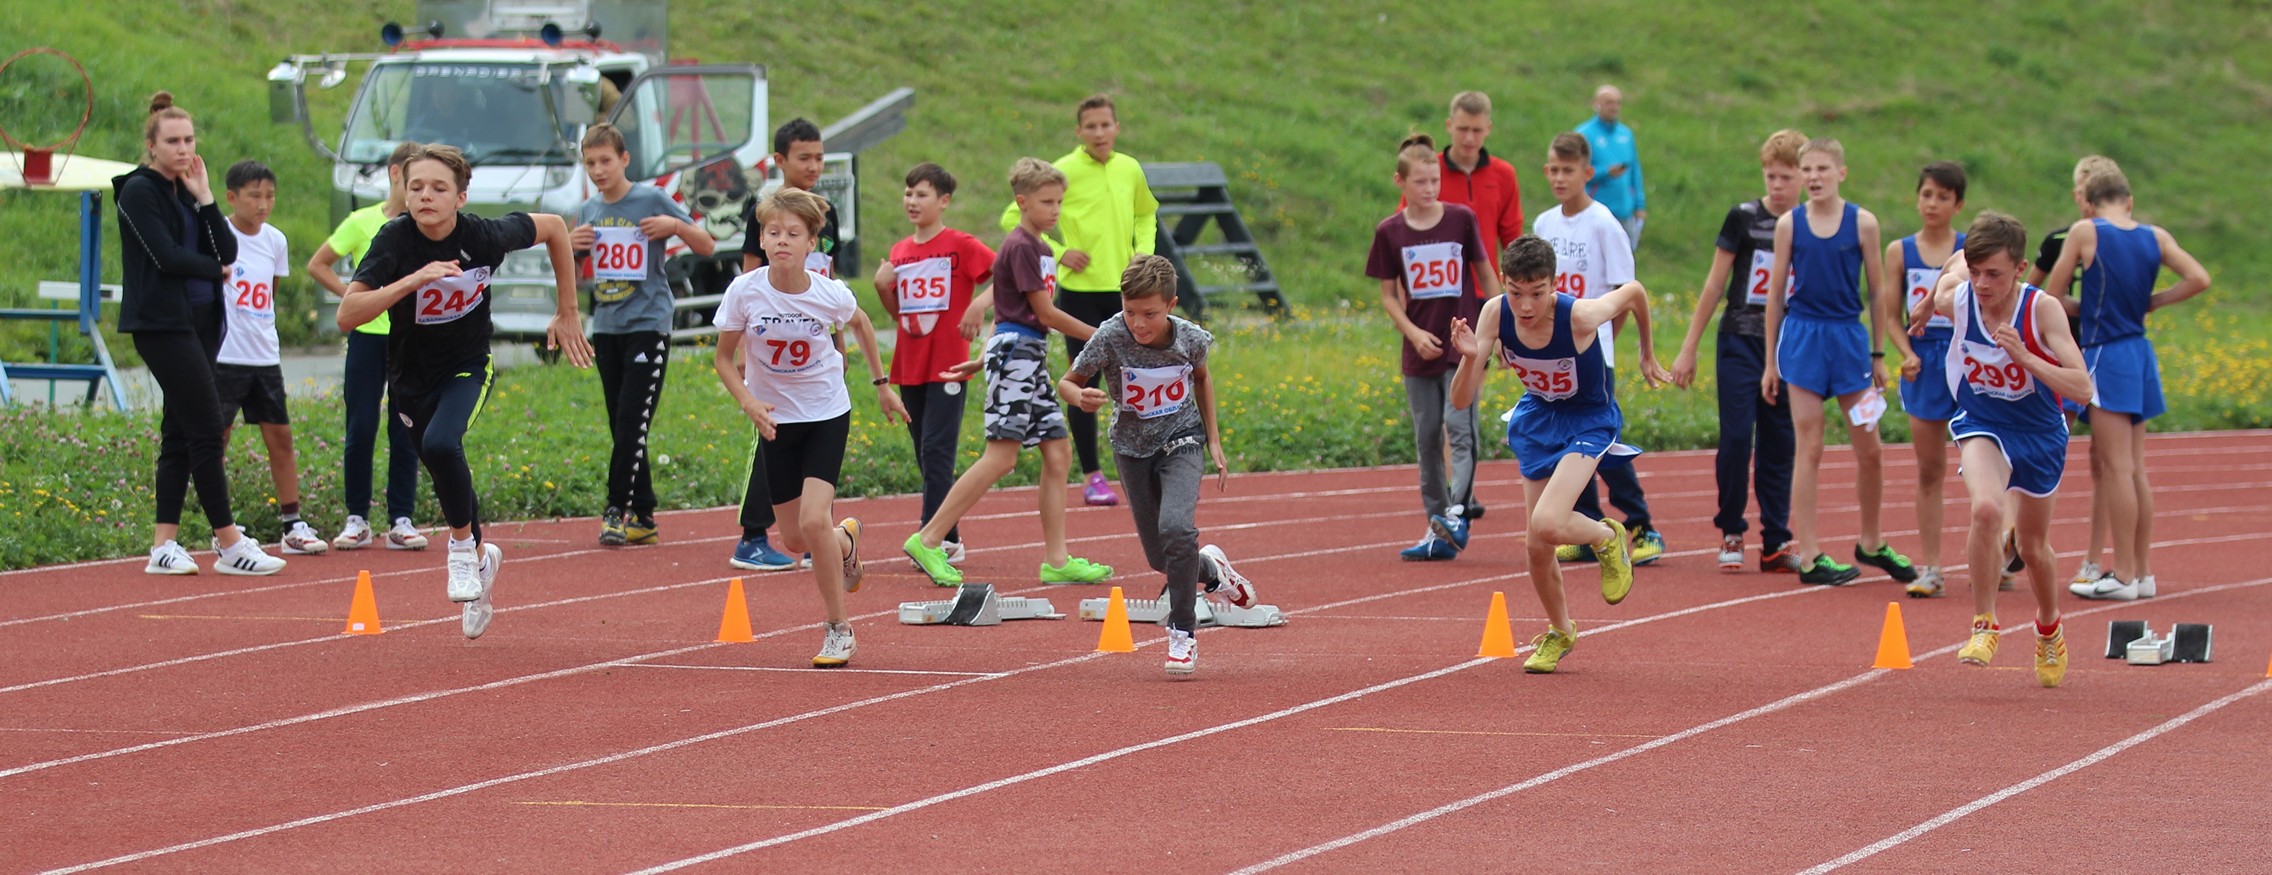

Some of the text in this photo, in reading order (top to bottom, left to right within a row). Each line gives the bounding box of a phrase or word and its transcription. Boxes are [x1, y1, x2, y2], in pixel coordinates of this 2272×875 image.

[596, 242, 643, 270] 280
[901, 276, 946, 300] 135
[1410, 258, 1459, 290] 250
[236, 280, 272, 310] 26
[421, 283, 485, 316] 244
[766, 339, 811, 367] 79
[1511, 362, 1573, 393] 235
[1964, 356, 2027, 391] 299
[1126, 377, 1185, 411] 210
